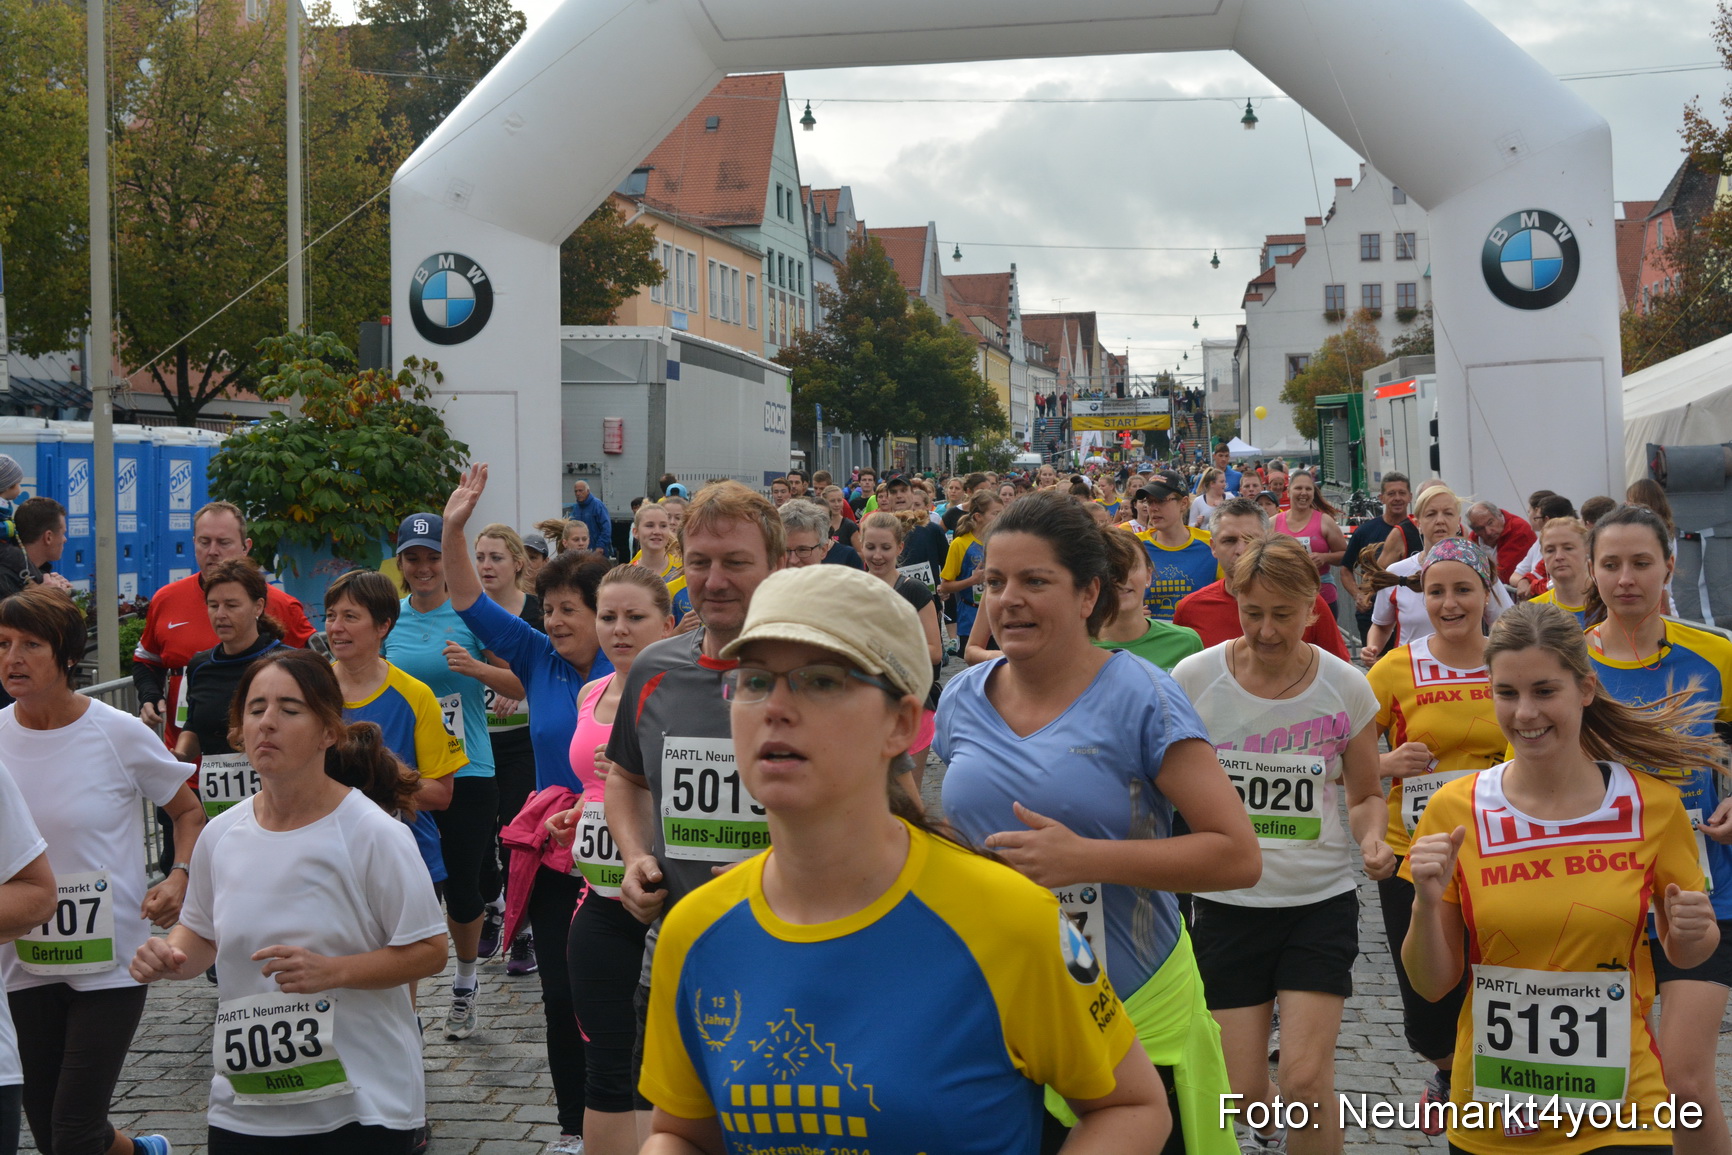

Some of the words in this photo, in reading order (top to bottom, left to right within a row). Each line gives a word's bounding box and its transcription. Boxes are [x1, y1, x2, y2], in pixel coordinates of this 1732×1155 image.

[1489, 212, 1572, 246] BMW
[414, 254, 486, 285] BMW
[1104, 418, 1138, 427] START
[1416, 689, 1464, 706] MAX
[1469, 686, 1493, 701] BÖ
[1243, 711, 1350, 754] ACTIV
[665, 749, 703, 761] PARTL
[1218, 758, 1253, 771] PARTL
[1255, 762, 1307, 774] Neumarkt
[206, 770, 263, 798] 5115
[1405, 780, 1435, 794] PARTL
[671, 823, 771, 848] Hans-Jürgen
[1253, 821, 1297, 836] sefine
[1481, 858, 1555, 887] MAX
[1564, 849, 1645, 876] BÖGL
[32, 945, 83, 961] Gertrud
[1476, 977, 1522, 995] PARTL
[1526, 984, 1601, 998] Neumarkt
[217, 1008, 251, 1025] PARTL
[252, 1001, 310, 1018] Neumarkt
[711, 997, 726, 1008] 15
[703, 1014, 731, 1026] Jahre
[1487, 999, 1607, 1058] 5131
[225, 1018, 323, 1072] 5033
[265, 1073, 304, 1090] Anita
[1500, 1065, 1596, 1094] Katharina
